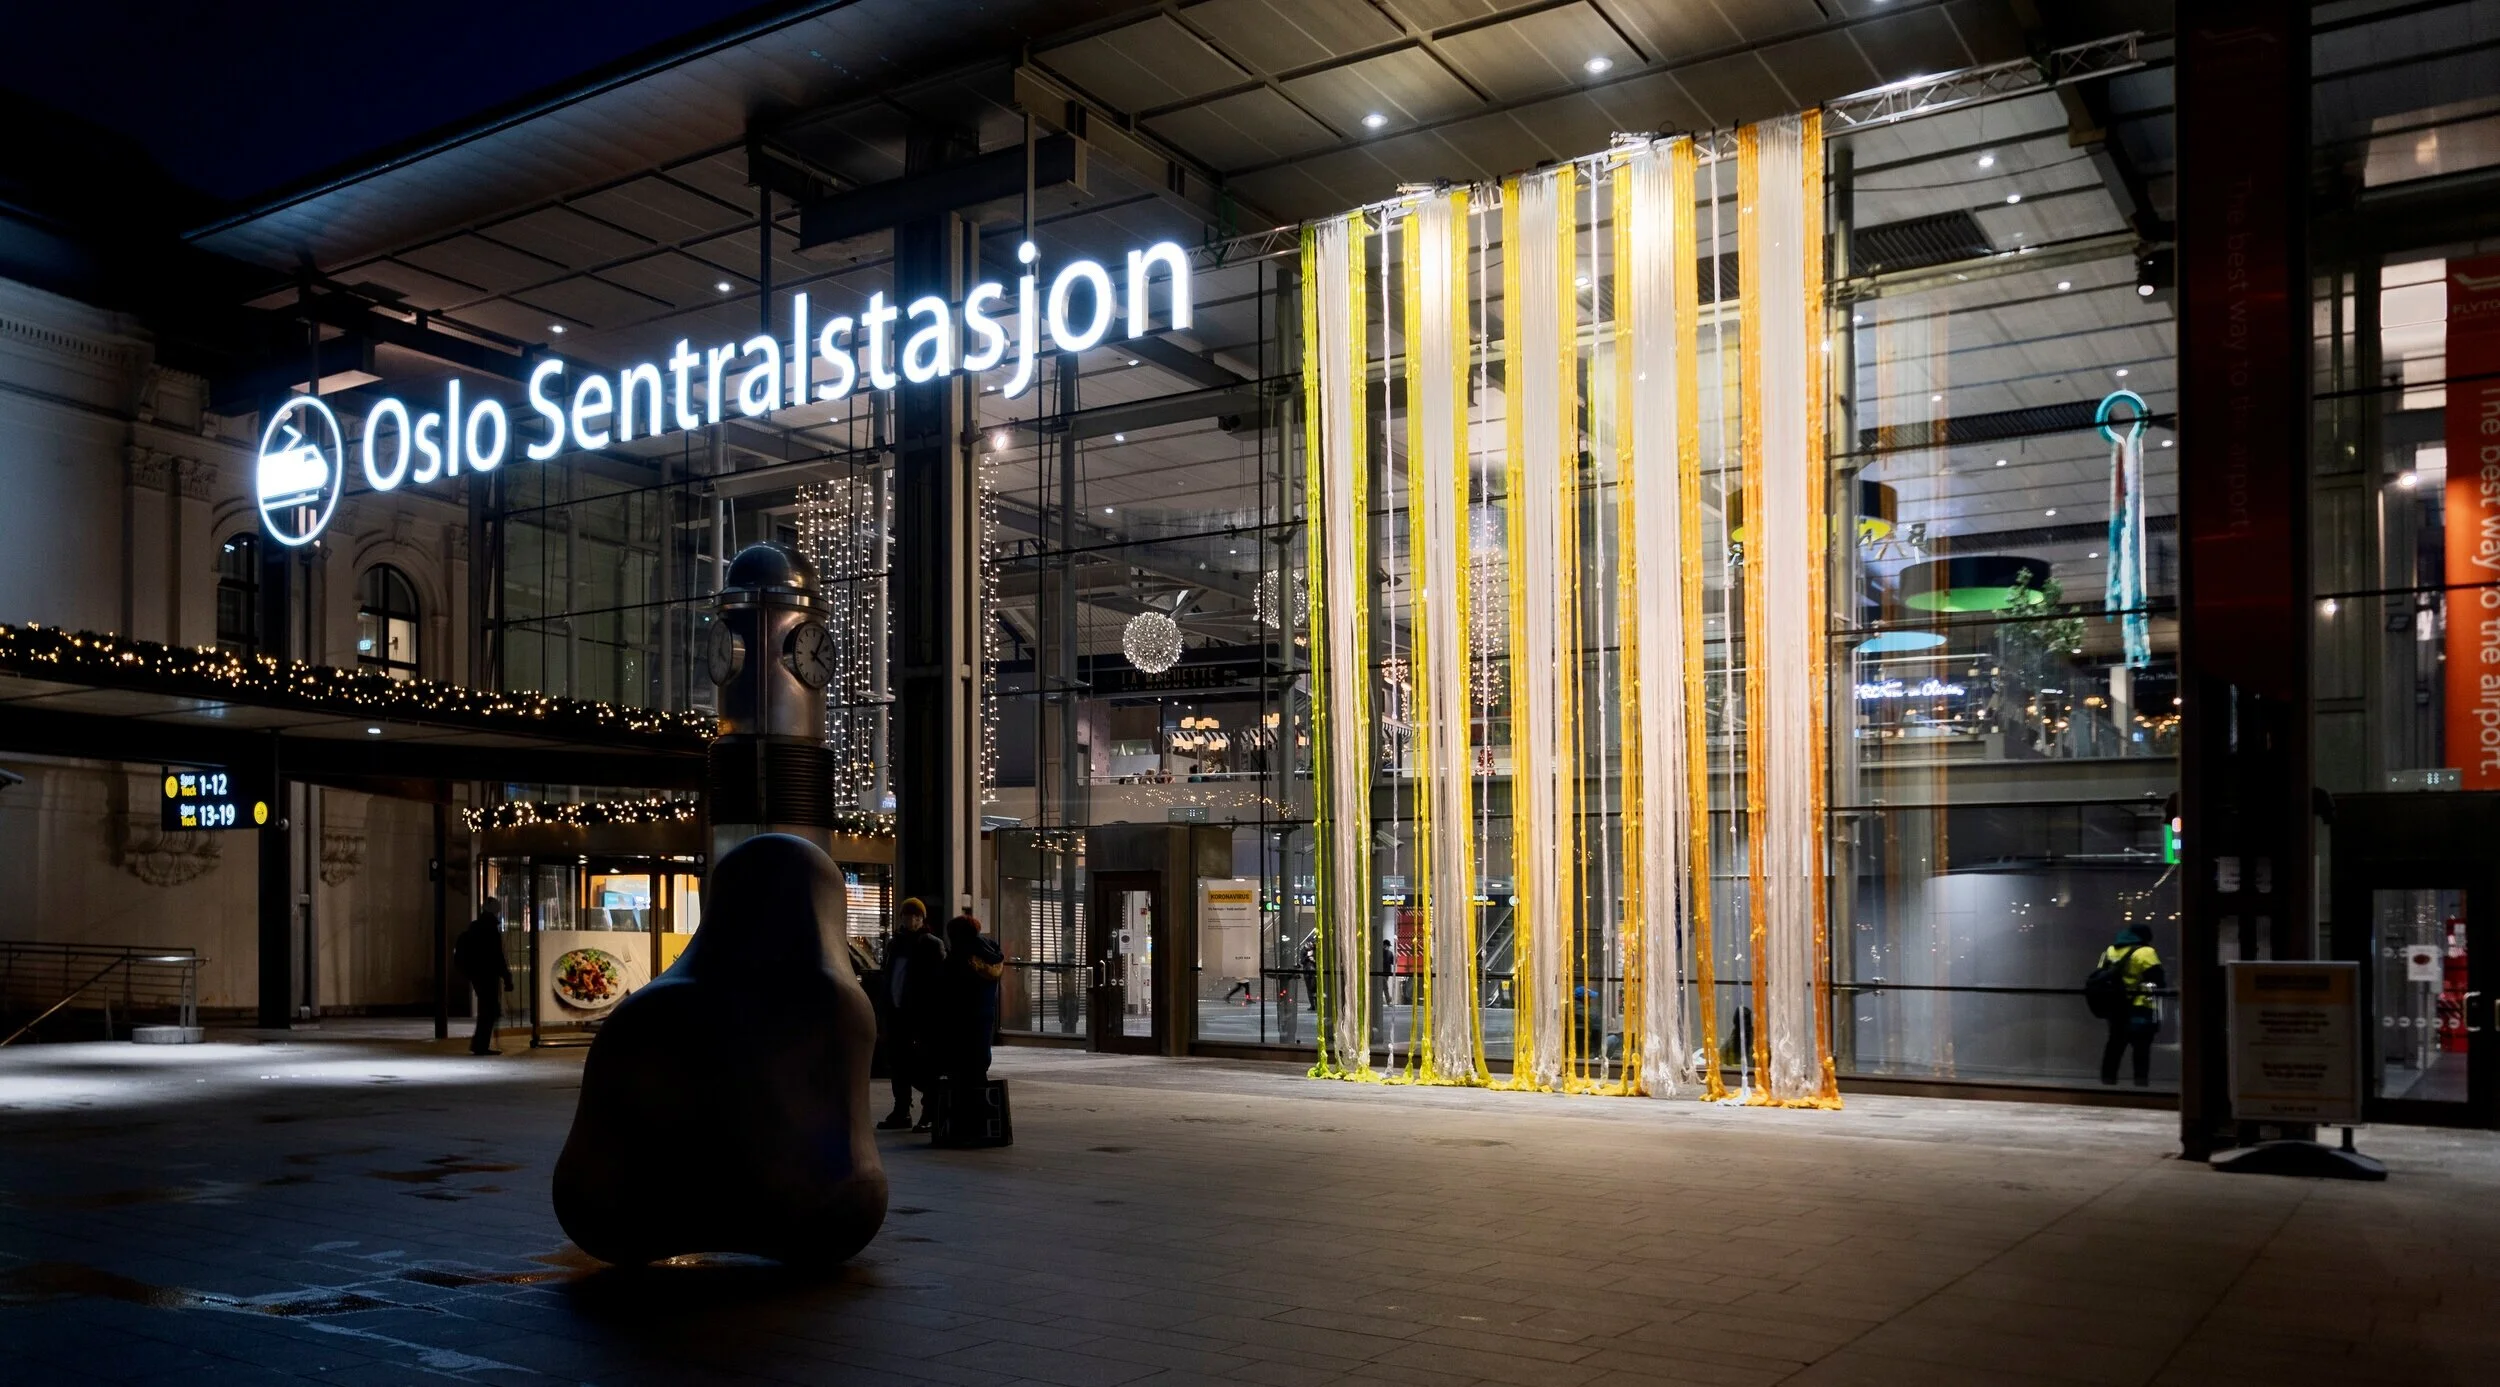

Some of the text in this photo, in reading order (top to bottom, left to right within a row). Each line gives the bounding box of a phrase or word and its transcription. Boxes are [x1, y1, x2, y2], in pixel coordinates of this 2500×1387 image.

[2222, 299, 2249, 351] way
[361, 240, 1194, 493] Oslo Sentralstasjon
[200, 773, 228, 796] 1-12
[200, 803, 236, 827] 13-19
